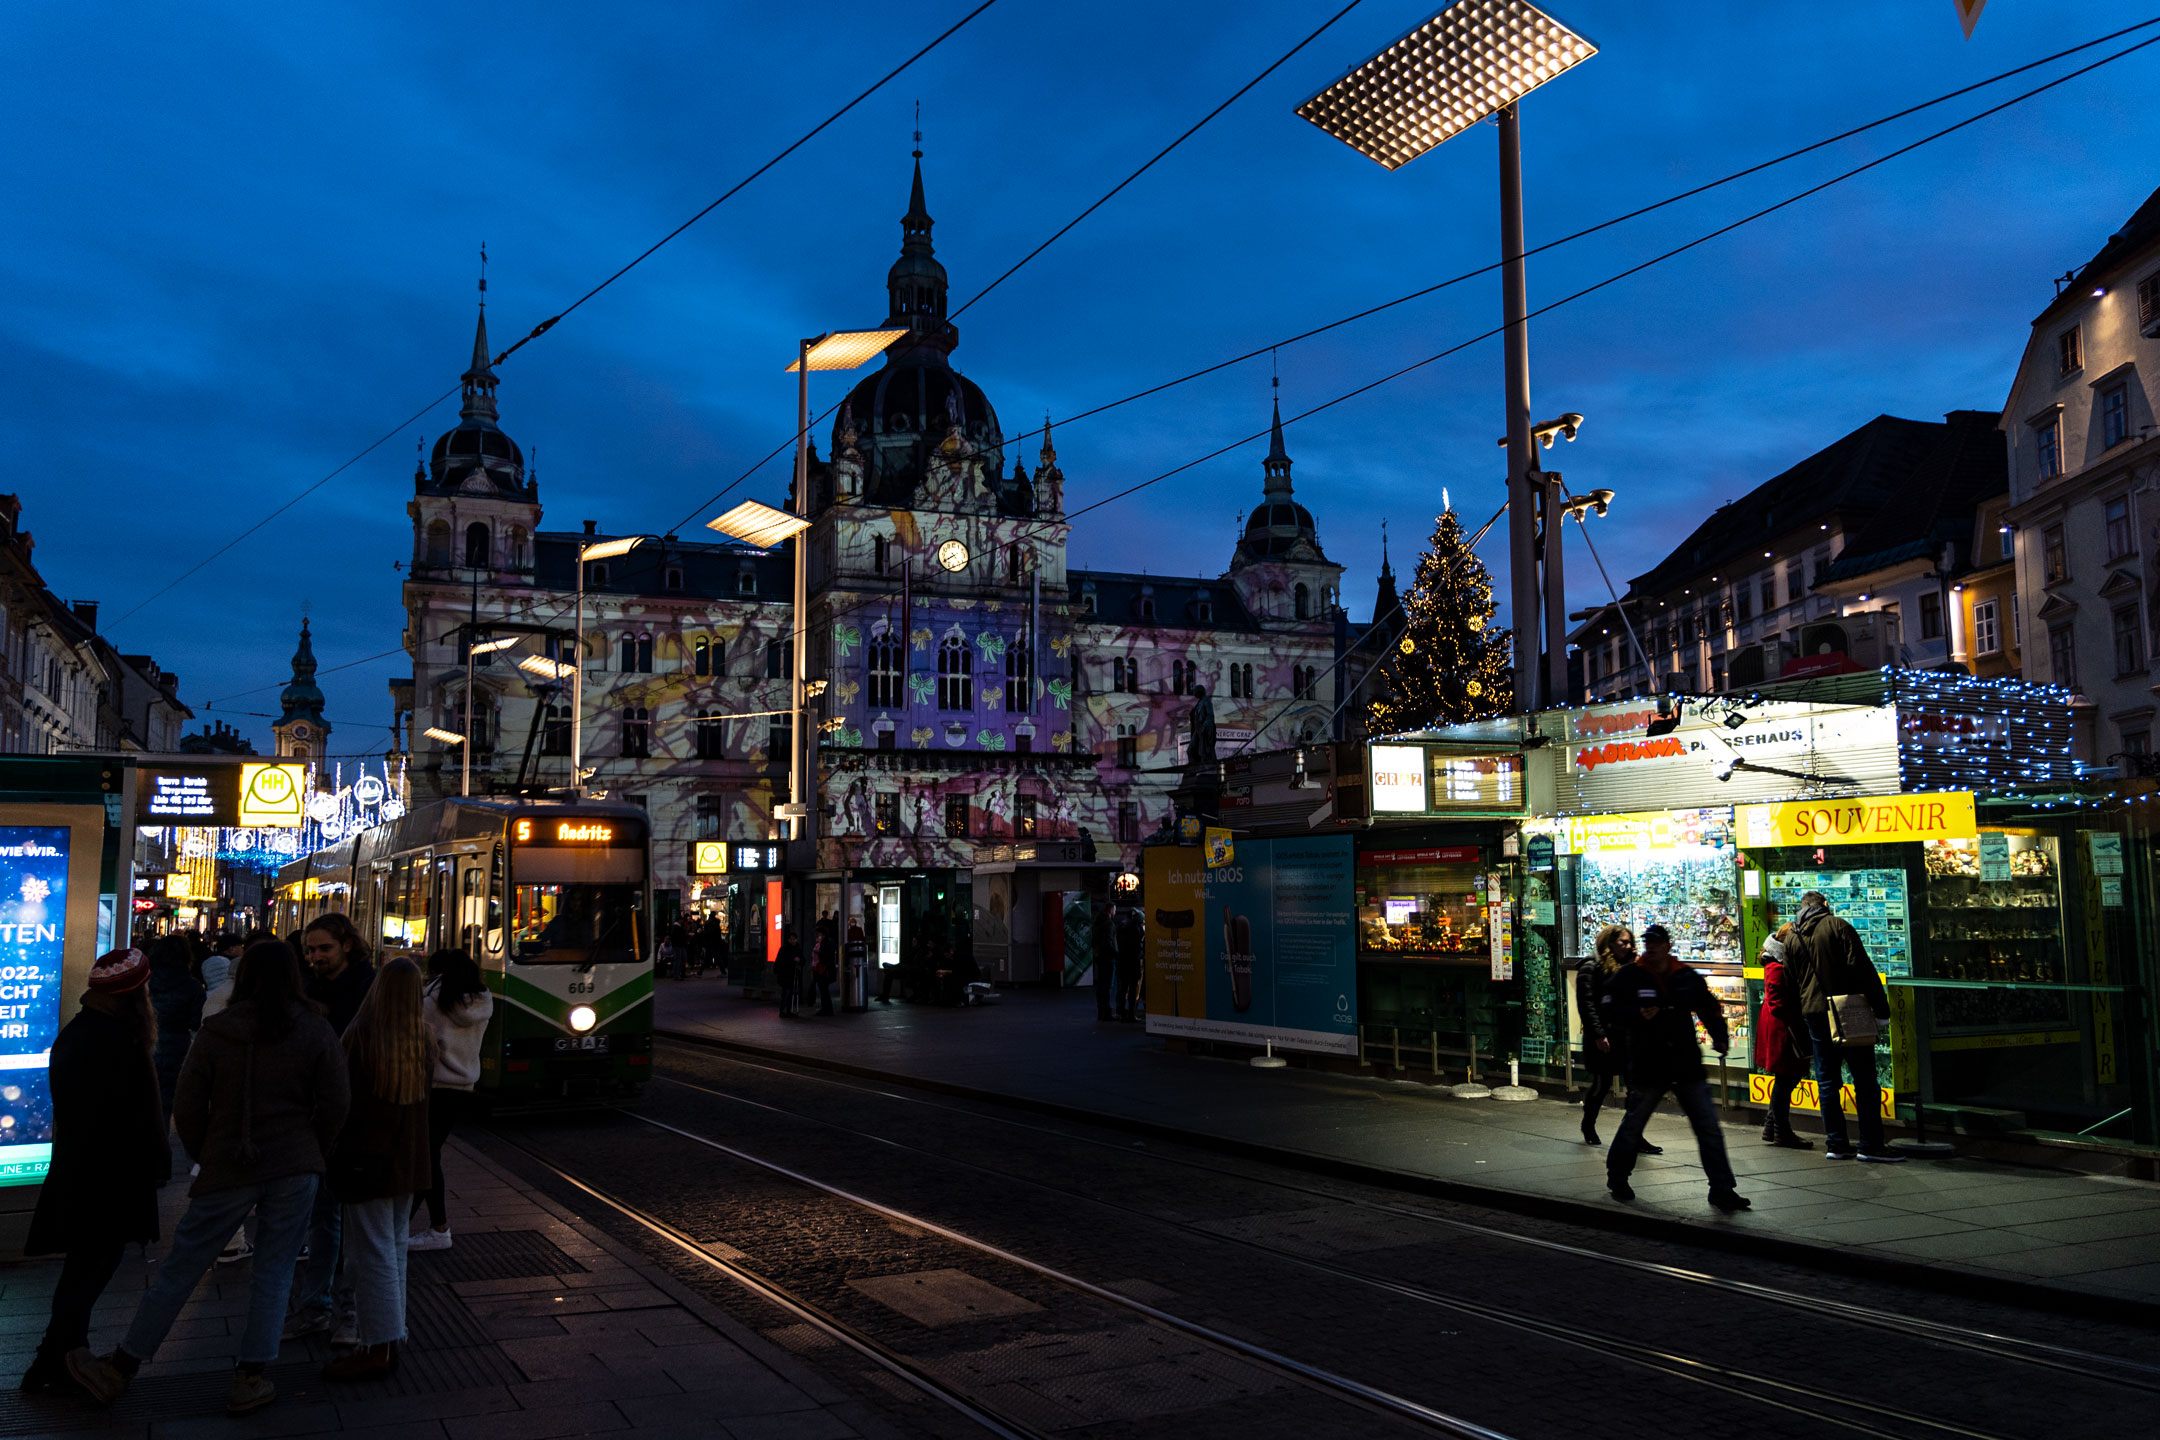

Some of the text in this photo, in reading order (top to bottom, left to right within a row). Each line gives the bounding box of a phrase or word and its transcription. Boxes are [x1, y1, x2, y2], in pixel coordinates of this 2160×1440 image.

[1576, 738, 1687, 770] MORAWA
[261, 774, 285, 790] HH
[1375, 772, 1422, 787] GRAZ
[1181, 818, 1200, 834] 50
[1795, 802, 1947, 837] SOUVENIR
[558, 823, 612, 841] Andritz
[1600, 834, 1636, 846] TICKETS
[1061, 848, 1076, 860] 15
[1168, 867, 1244, 884] Ich nutze IQOS
[1232, 952, 1241, 963] gilt
[1242, 953, 1256, 962] auch
[0, 966, 44, 981] 022,
[569, 982, 595, 994] 609
[555, 1036, 609, 1050] GRAZ
[1897, 986, 1910, 1090] SOUVENIR
